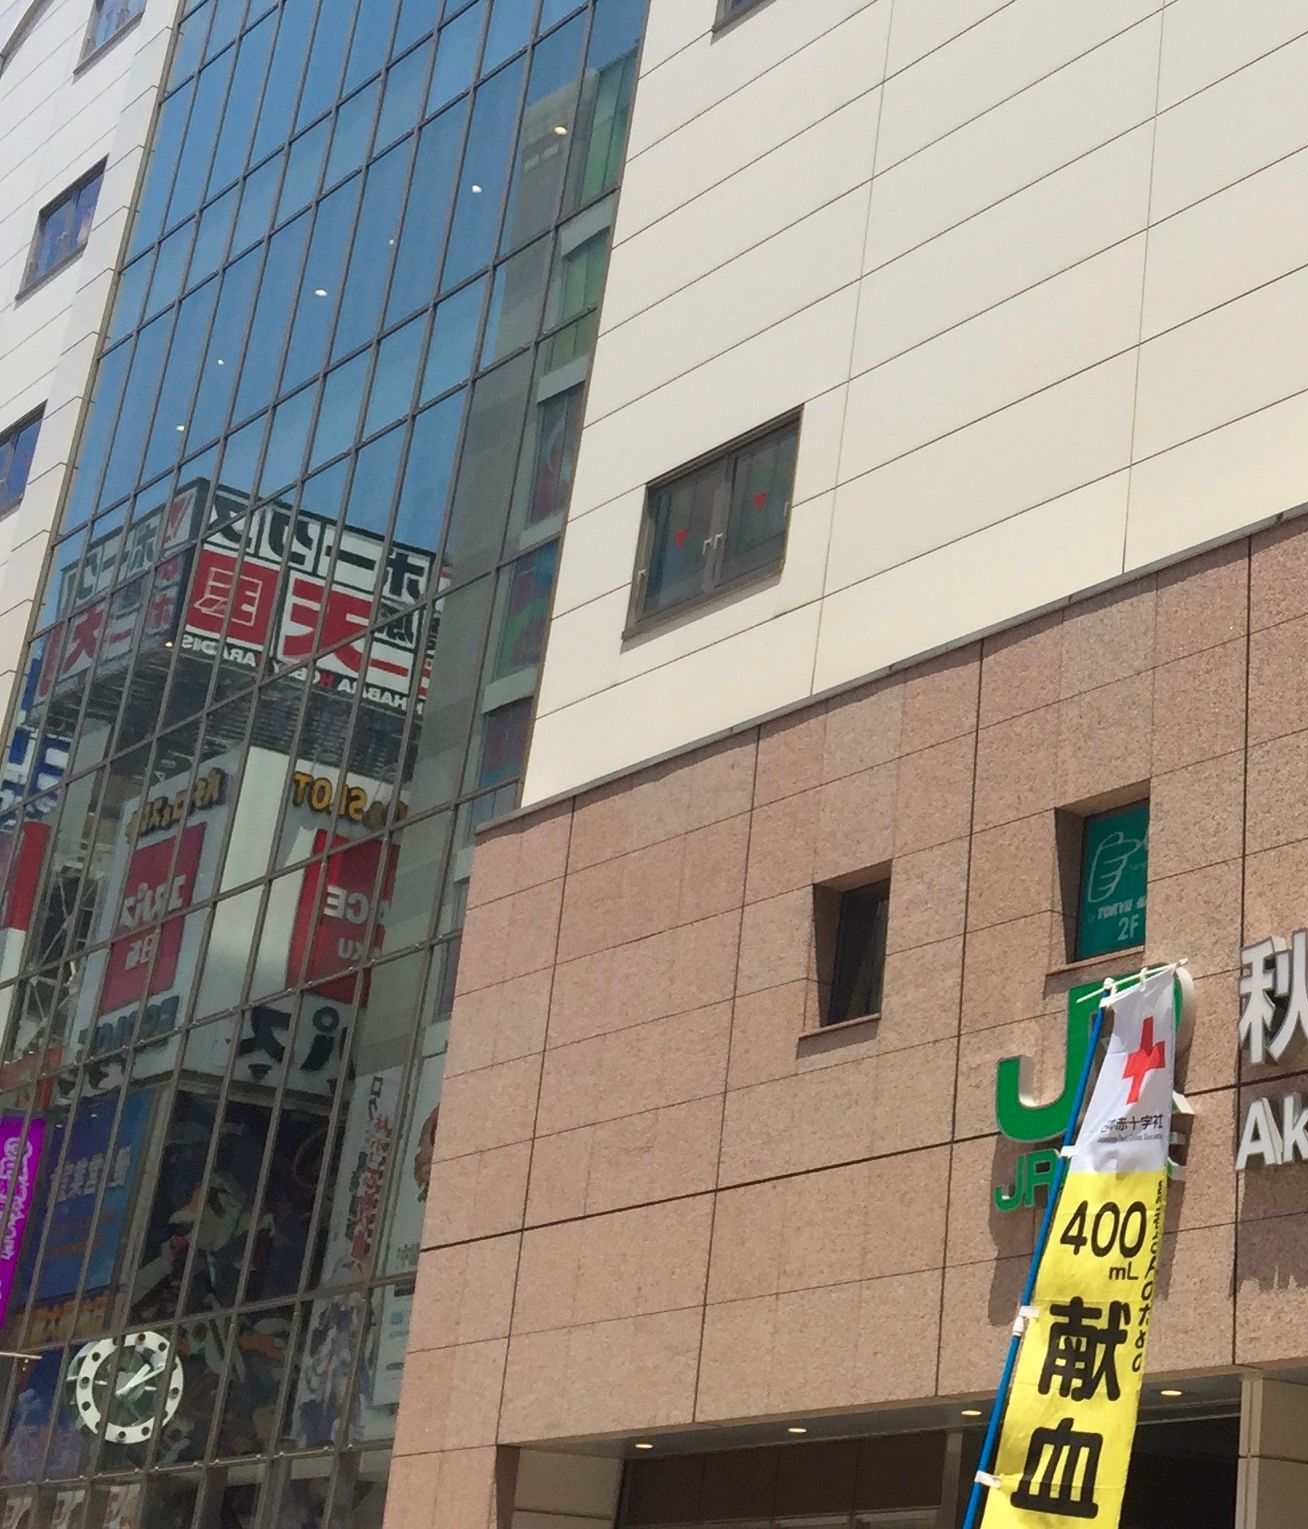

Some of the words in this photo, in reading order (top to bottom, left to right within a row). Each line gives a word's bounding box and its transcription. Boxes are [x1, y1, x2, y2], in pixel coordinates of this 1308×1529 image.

[1117, 914, 1139, 941] 2F
[1060, 1200, 1146, 1258] 400
[1109, 1262, 1139, 1281] mL
[1010, 1296, 1130, 1520] 献血
